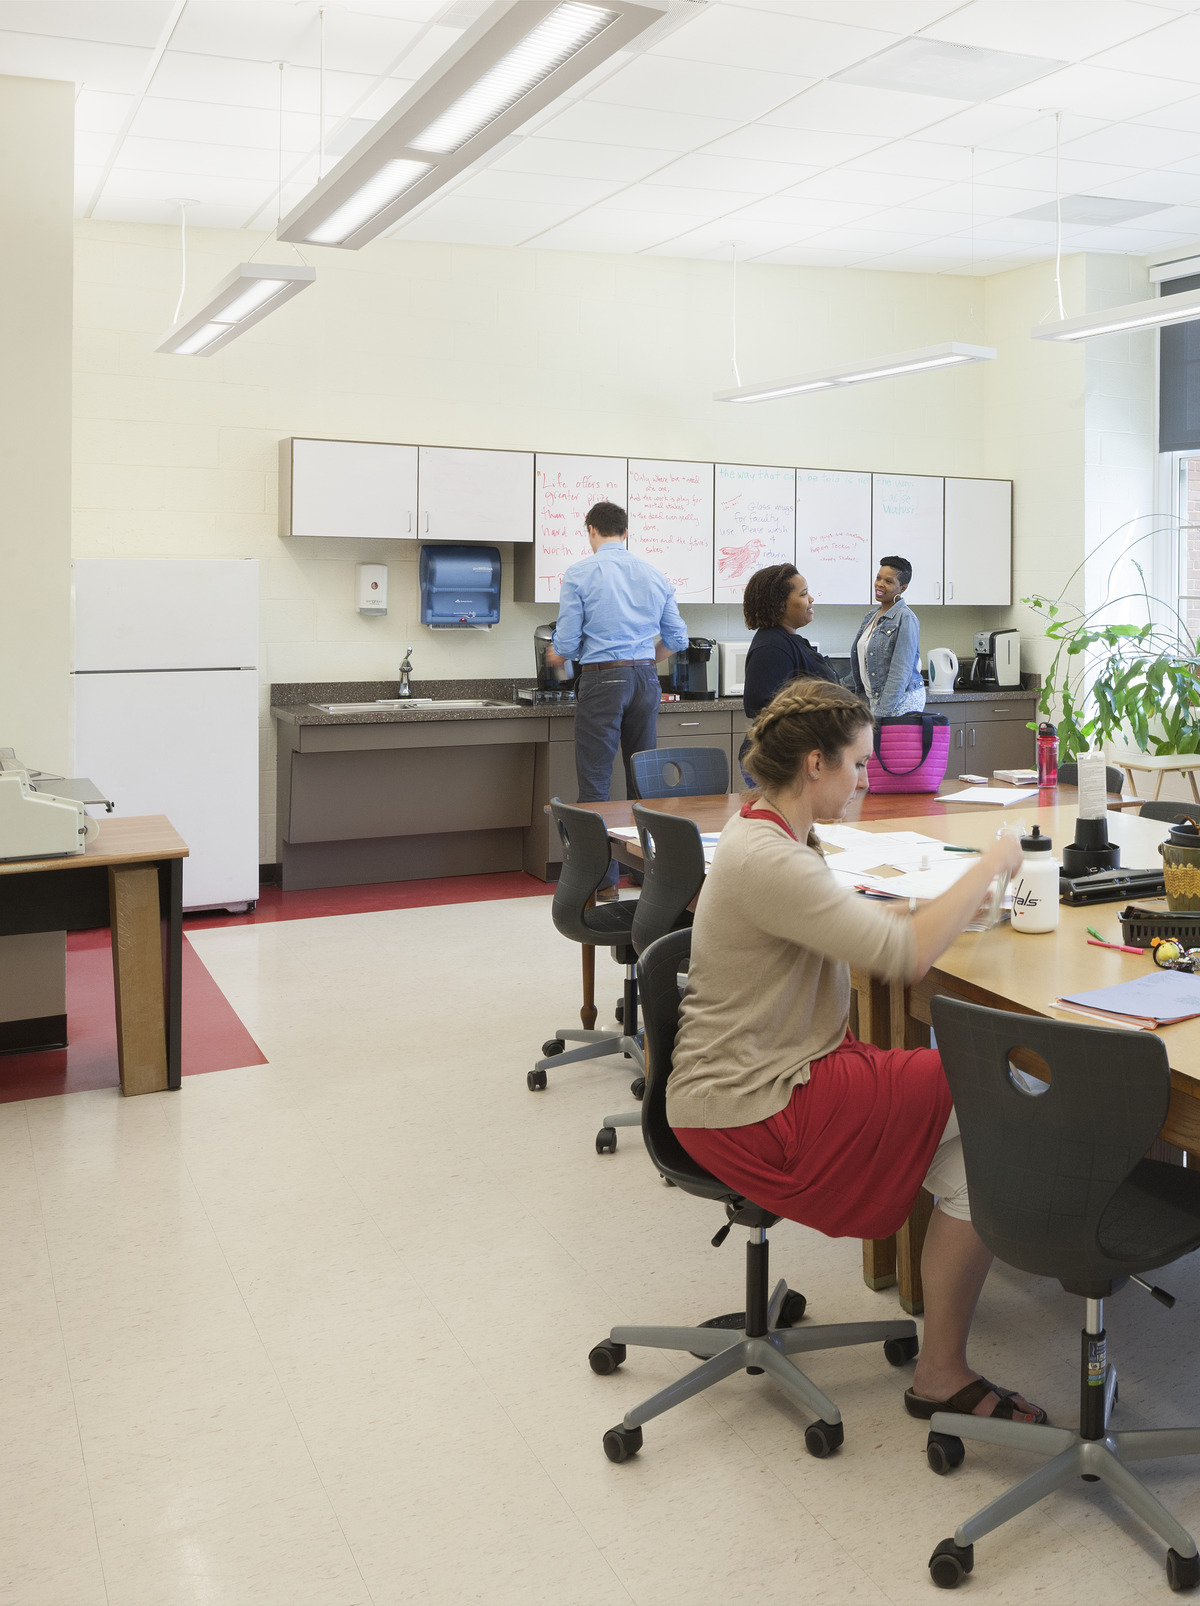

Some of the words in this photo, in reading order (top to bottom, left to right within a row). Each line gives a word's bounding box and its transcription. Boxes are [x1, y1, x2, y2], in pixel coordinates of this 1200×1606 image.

[575, 474, 600, 489] offers
[720, 468, 735, 479] the
[737, 472, 755, 482] way
[759, 469, 780, 480] that
[544, 489, 580, 507] greater
[588, 492, 609, 506] prize
[541, 506, 566, 520] than
[571, 507, 580, 518] to
[747, 501, 771, 511] Glass
[775, 503, 794, 515] mugs
[749, 511, 779, 529] faculty
[541, 524, 568, 537] hard
[741, 524, 764, 534] Please
[660, 534, 674, 544] and
[676, 536, 687, 544] the
[542, 543, 573, 556] worth
